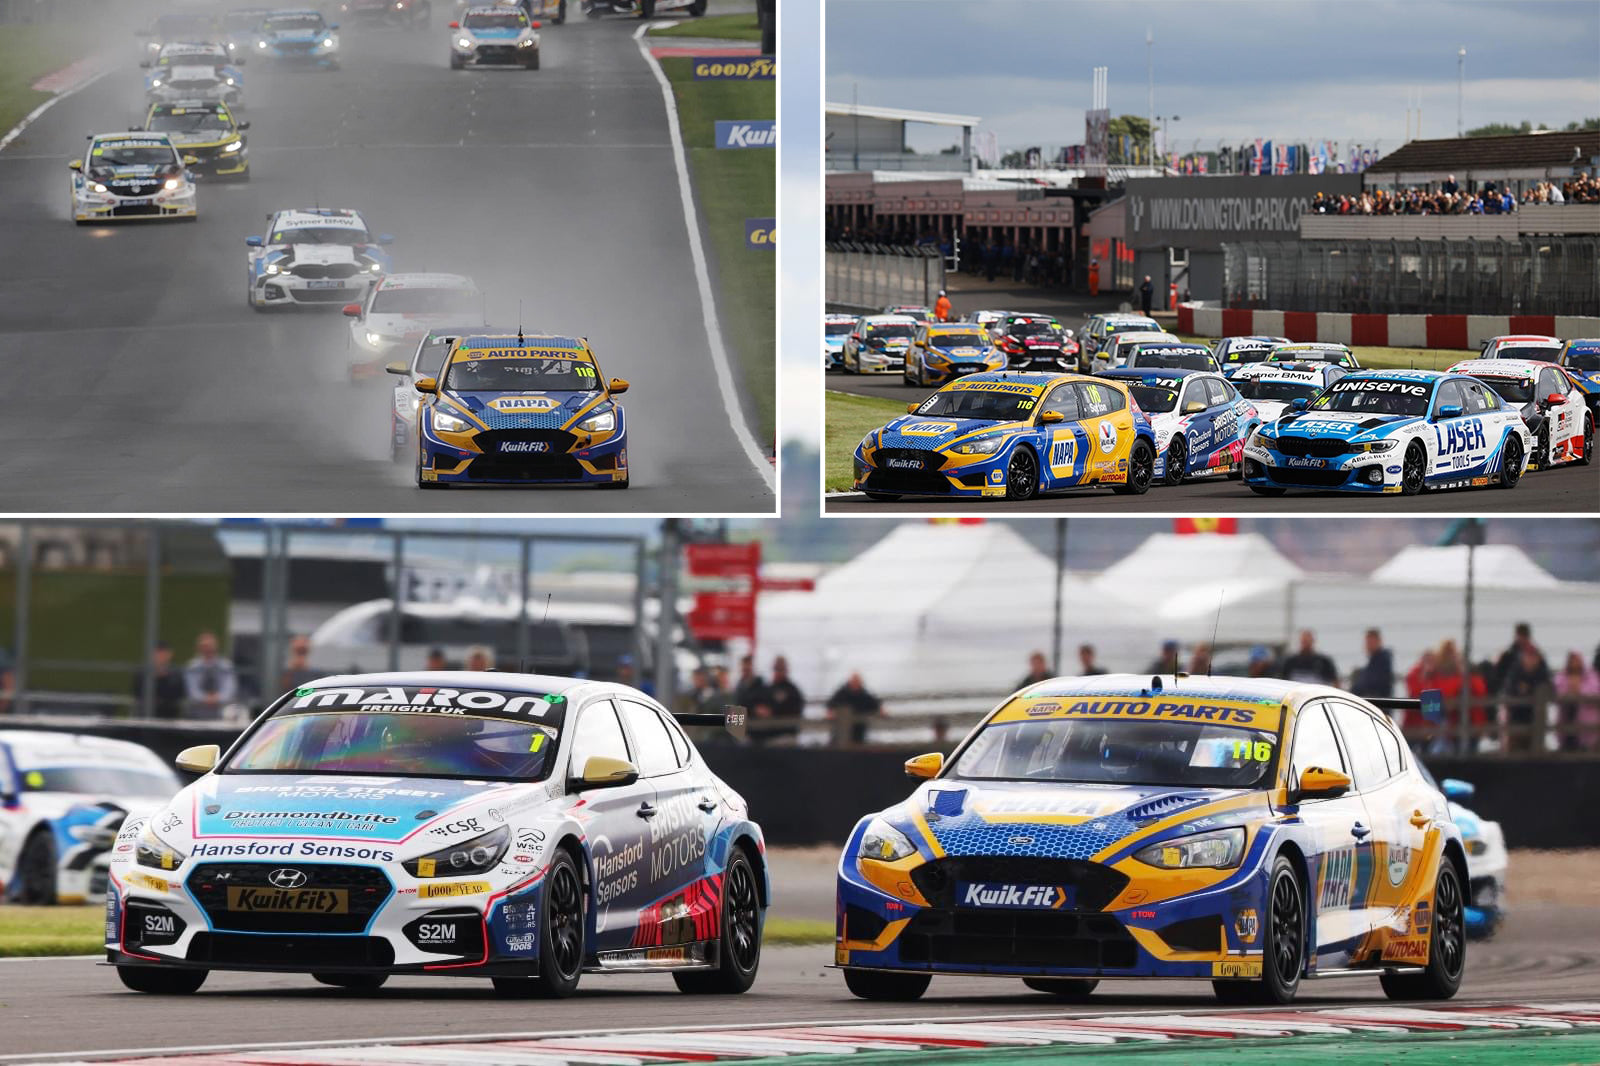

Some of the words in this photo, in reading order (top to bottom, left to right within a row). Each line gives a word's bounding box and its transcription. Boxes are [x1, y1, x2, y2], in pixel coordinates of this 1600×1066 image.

[488, 350, 527, 358] AUTO
[530, 350, 578, 359] PARTS
[575, 366, 595, 378] 116
[1242, 372, 1279, 380] Sytner
[1281, 373, 1314, 381] BMW
[967, 382, 998, 391] AUTO
[998, 383, 1035, 394] PARTS
[500, 400, 549, 408] NAPA
[1017, 400, 1034, 410] 116
[1213, 407, 1237, 430] BRISTOL
[1288, 420, 1355, 431] LASER
[907, 423, 951, 433] NAPA
[1214, 421, 1239, 445] MOTORS
[1434, 418, 1486, 456] LASER
[501, 442, 545, 452] KwikFit
[1052, 441, 1074, 466] NAPA
[888, 459, 921, 469] KwikFit
[1289, 457, 1322, 468] KwikFit
[1452, 454, 1470, 470] TOOLS
[360, 705, 437, 713] FREIGHT
[440, 707, 469, 715] UK
[1066, 702, 1151, 715] AUTO
[1153, 704, 1256, 722] PARTS
[529, 734, 545, 752] 1
[1232, 741, 1273, 762] 116
[235, 785, 339, 795] BRISTOL
[346, 786, 446, 798] STREET
[279, 791, 387, 801] MOTORS
[224, 811, 399, 825] Diamondbrite
[445, 817, 486, 833] csg
[190, 842, 295, 858] Hansford
[300, 842, 394, 863] Sensors
[516, 842, 544, 851] WSC
[650, 824, 705, 884] MOTORS
[599, 836, 643, 880] Hansford
[597, 870, 638, 905] Sensors
[965, 884, 1055, 906] KwikFit
[237, 889, 328, 910] KwikFit
[145, 915, 174, 932] S2M
[418, 924, 456, 939] S2M
